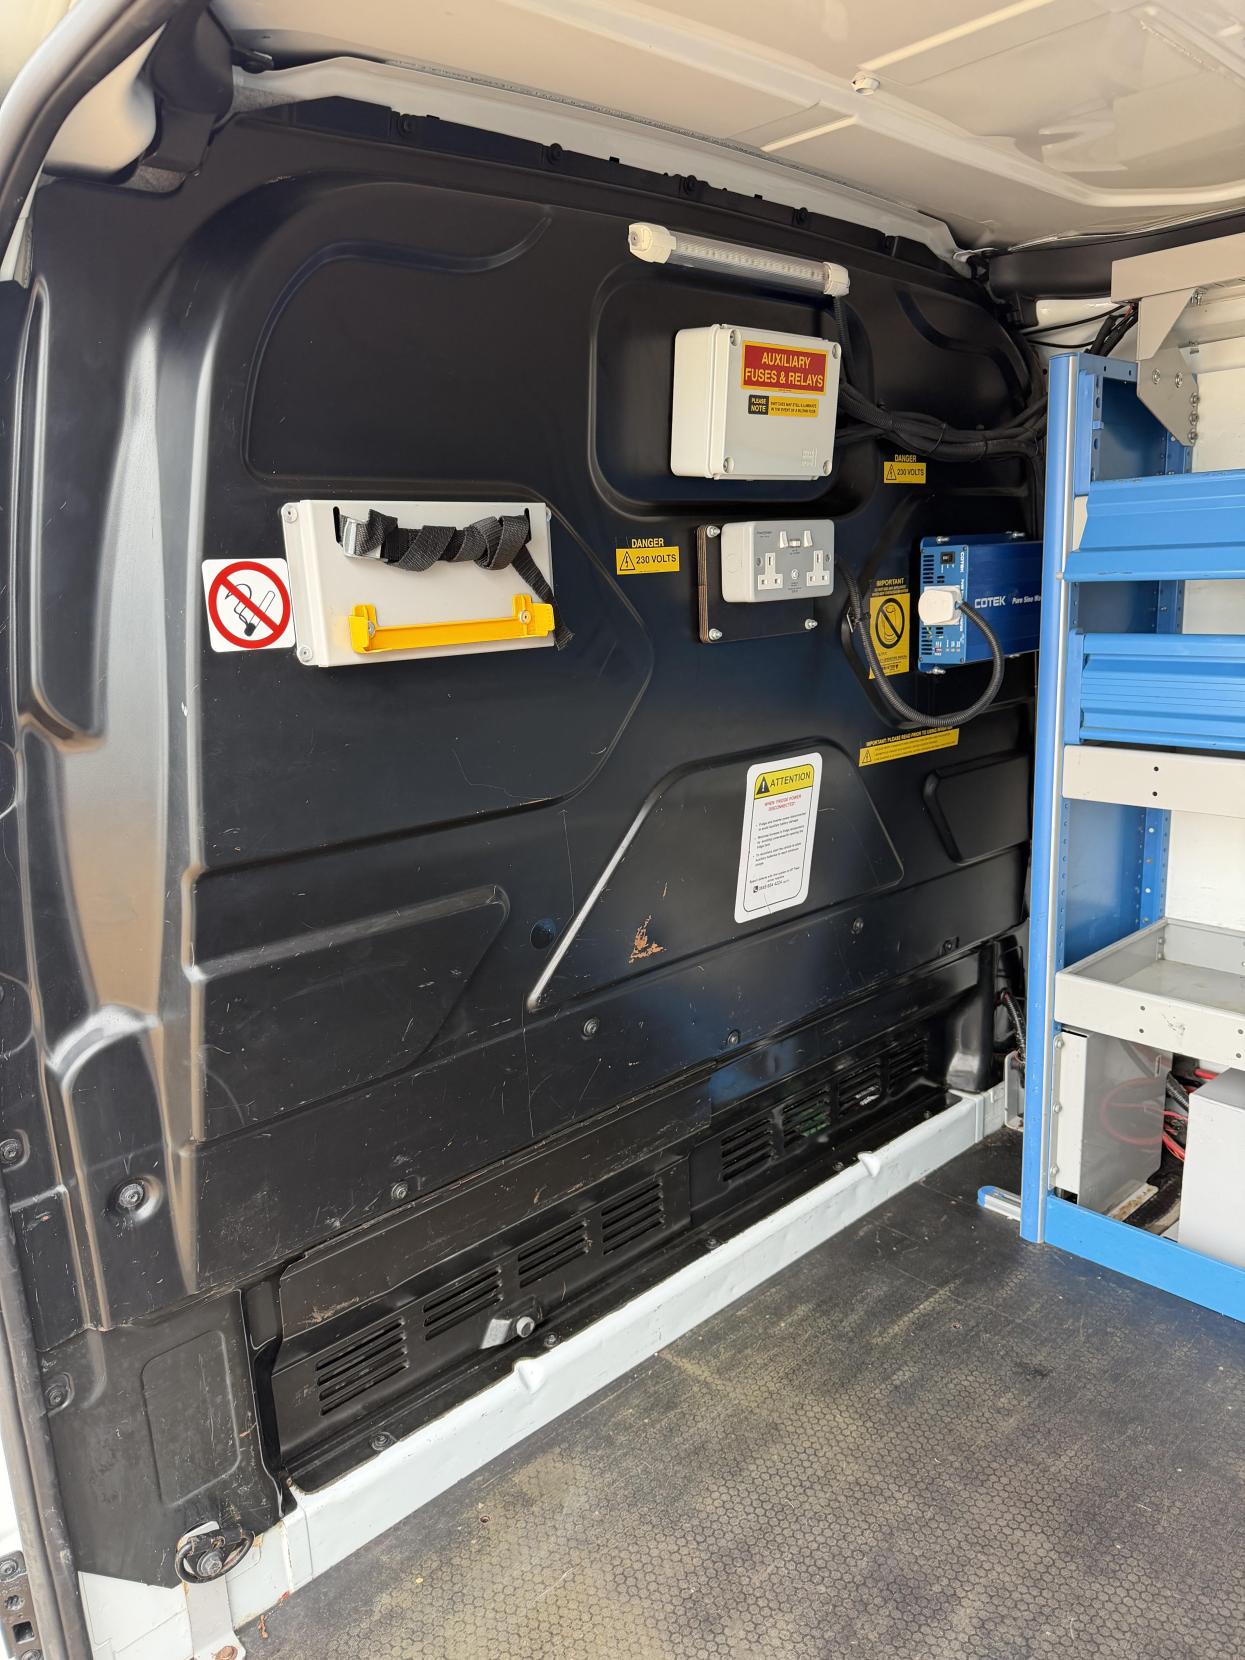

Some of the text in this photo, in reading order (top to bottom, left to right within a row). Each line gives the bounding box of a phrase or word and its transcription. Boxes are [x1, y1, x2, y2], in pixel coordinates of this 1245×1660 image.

[762, 352, 811, 369] AUXILIARY
[745, 367, 824, 387] FUSES & RELAYS
[751, 405, 767, 413] NOTE
[894, 454, 917, 463] DANGER
[907, 468, 924, 476] VOLTS
[631, 537, 665, 548] DANGER
[636, 553, 677, 565] 230 VOLTS
[876, 577, 905, 587] IMPORTANT
[974, 595, 1007, 609] COTEK
[769, 771, 811, 788] ATTENTION
